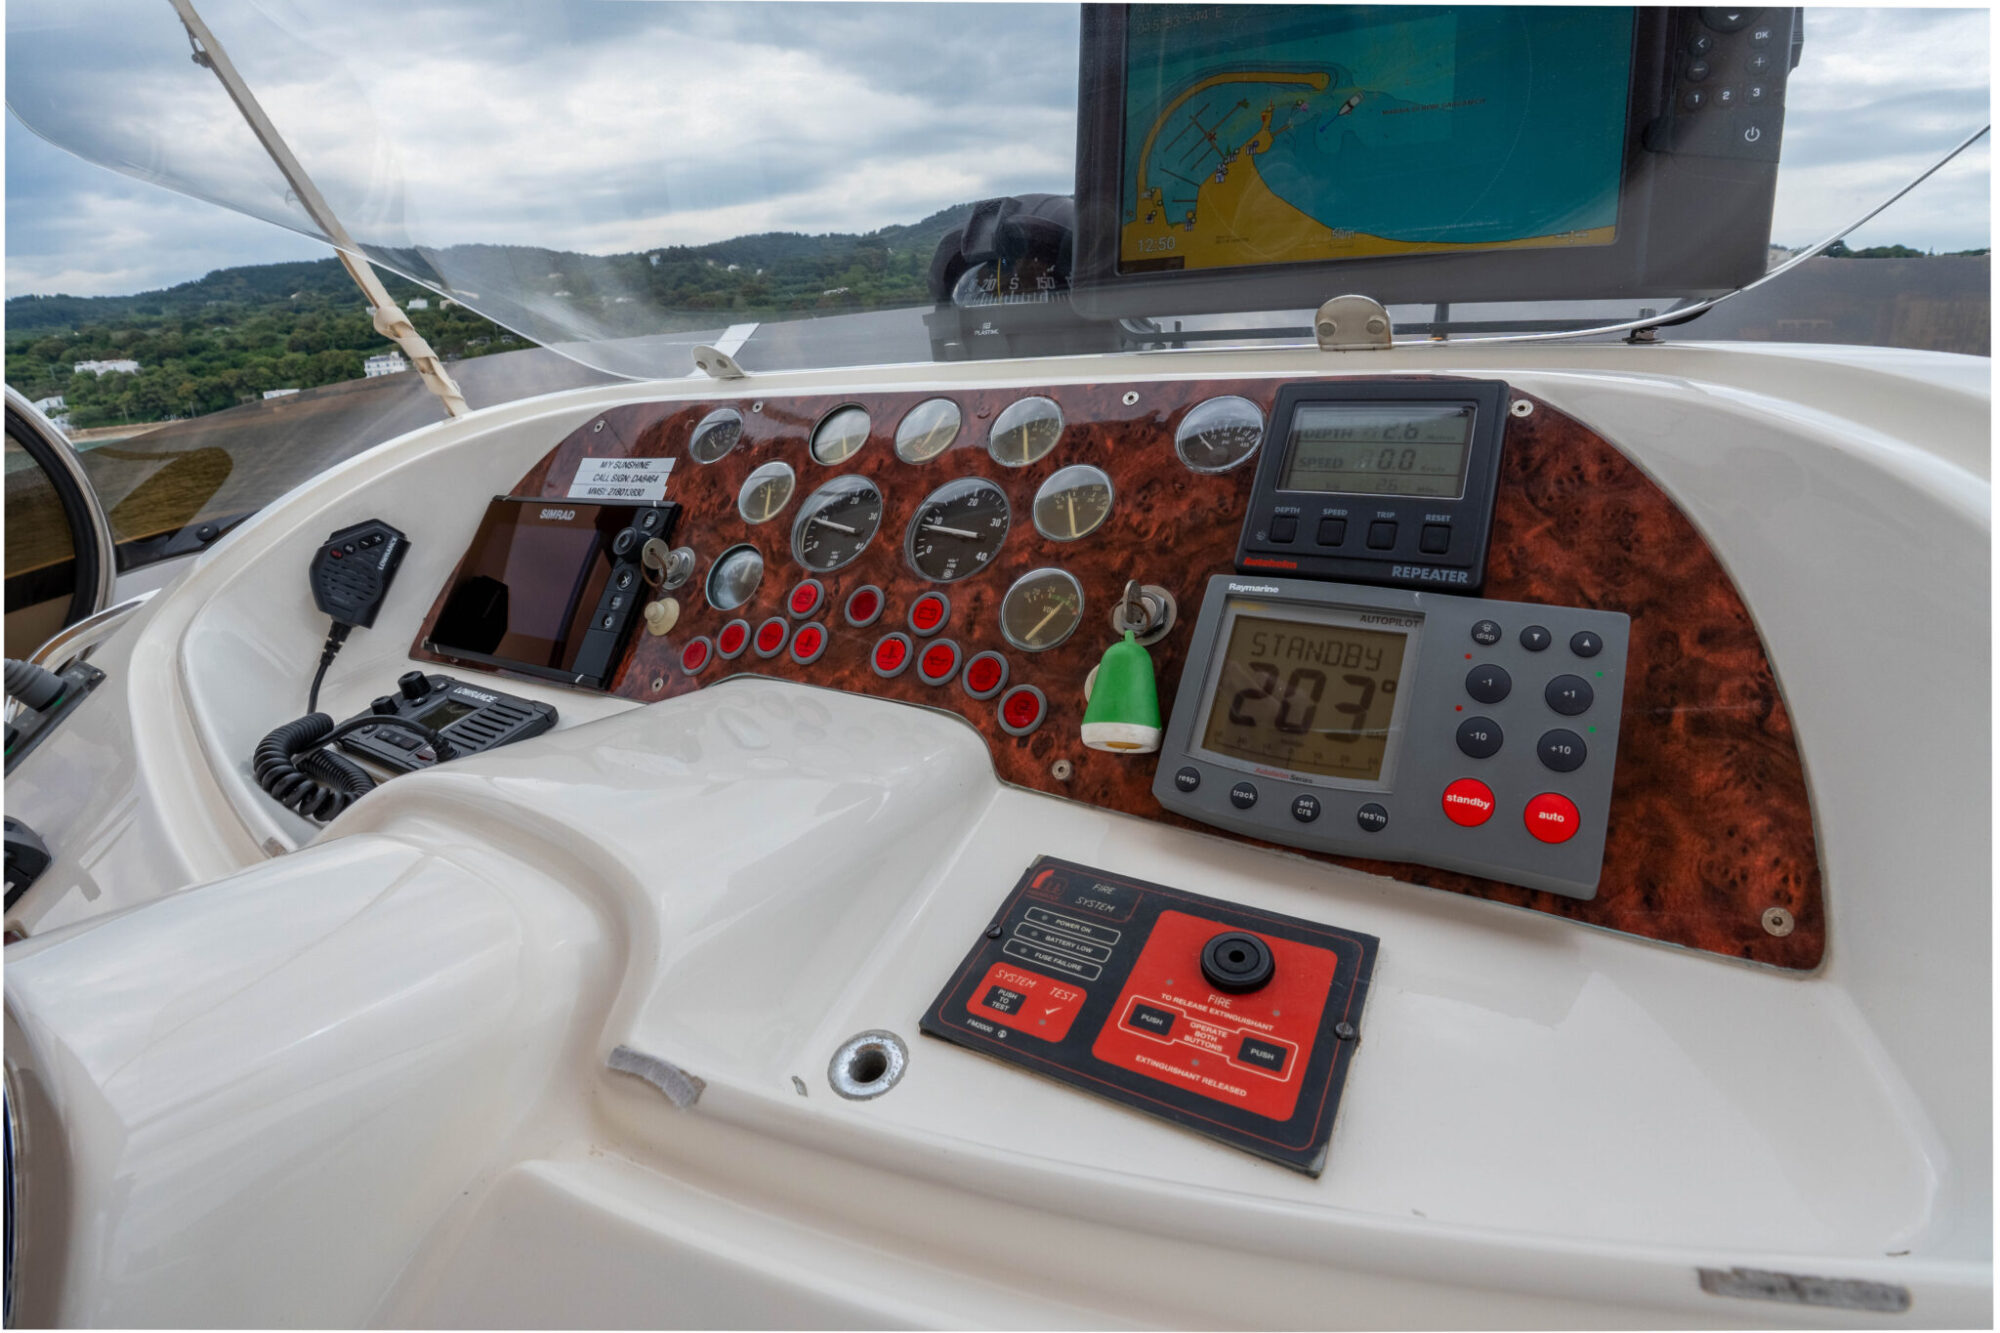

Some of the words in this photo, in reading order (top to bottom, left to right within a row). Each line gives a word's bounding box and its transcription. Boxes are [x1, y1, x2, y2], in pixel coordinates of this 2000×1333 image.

[1755, 31, 1769, 40] OK
[1694, 94, 1700, 103] 1
[1722, 91, 1731, 101] 2
[1753, 88, 1761, 97] 3
[1010, 277, 1020, 290] S
[1036, 277, 1055, 290] 150
[613, 461, 653, 469] SUNSHINE
[1300, 456, 1344, 469] SPEED
[1376, 449, 1416, 470] 0.0
[968, 498, 979, 507] 20
[540, 509, 575, 521] SIMRAD
[934, 516, 943, 526] 10
[1274, 506, 1300, 515] DEPTH
[1323, 508, 1348, 517] SPEED
[1376, 511, 1395, 520] TRIP
[1425, 514, 1451, 523] RESET
[990, 517, 1002, 528] 30
[926, 545, 933, 554] 0
[976, 551, 988, 562] 40
[1392, 565, 1468, 583] REPEATER
[1229, 583, 1279, 594] Raymarine
[1360, 615, 1420, 628] AUTOPILOT
[1477, 632, 1495, 642] disp
[1252, 632, 1383, 672] STANDBY
[1482, 678, 1493, 687] -1
[1563, 690, 1576, 699] +1
[1470, 732, 1487, 741] -10
[1550, 745, 1571, 755] +10
[1178, 775, 1196, 785] resp
[1233, 789, 1254, 800] track
[1299, 800, 1314, 809] set
[1447, 794, 1491, 810] standby
[1297, 808, 1312, 817] crs
[1360, 811, 1386, 823] res'm
[1538, 811, 1565, 823] auto
[1092, 883, 1117, 895] FIRE
[1075, 896, 1116, 913] SYSTEM
[1055, 919, 1078, 930] POWER
[1045, 935, 1075, 948] BATTERY
[1076, 943, 1093, 953] LOW
[1035, 952, 1052, 962] FUSE
[1053, 957, 1082, 972] FAILURE
[995, 969, 1037, 988] SYSTEM
[1050, 986, 1078, 1002] TEST
[998, 989, 1018, 1000] PUSH
[1000, 996, 1010, 1004] TO
[1207, 994, 1232, 1008] FIRE
[991, 1001, 1010, 1011] TEST
[1161, 993, 1172, 1001] TO
[1172, 995, 1207, 1012] RELEASE
[1208, 1006, 1274, 1031] EXTINGUISHANT
[1140, 1013, 1163, 1026] PUSH
[1189, 1021, 1228, 1038] OPERATE
[1184, 1035, 1223, 1052] BUTTONS
[1194, 1031, 1218, 1043] BOTH
[1250, 1048, 1275, 1061] PUSH
[1135, 1054, 1201, 1081] EXTINGUISHANT
[1201, 1076, 1247, 1097] RELEASED
